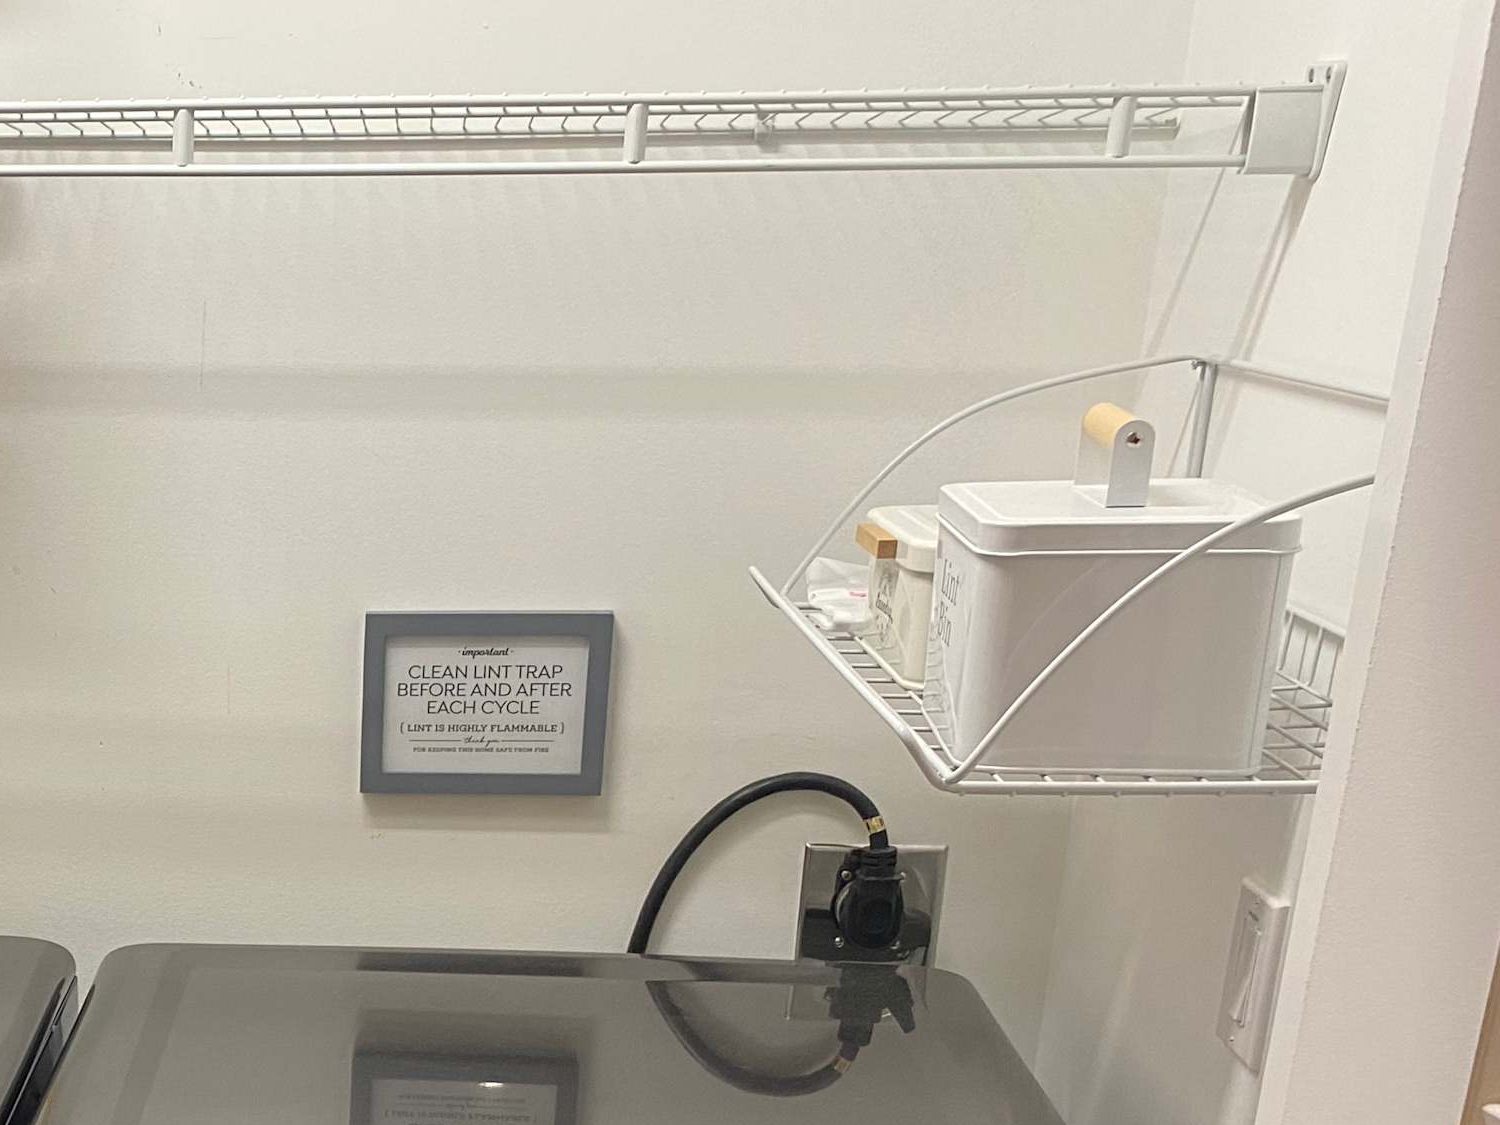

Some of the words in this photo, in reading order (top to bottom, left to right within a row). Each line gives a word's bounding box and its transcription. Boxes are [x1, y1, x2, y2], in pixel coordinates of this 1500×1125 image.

[941, 558, 959, 606] Lint
[938, 601, 951, 647] Bin
[461, 646, 509, 659] important
[408, 665, 468, 679] CLEAN
[473, 665, 512, 679] LINT
[515, 665, 563, 679] TRAP
[397, 682, 467, 697] BEFORE
[470, 682, 512, 697] AND
[515, 682, 572, 697] AFTER
[427, 700, 476, 715] EACH
[481, 700, 541, 715] CYCLE
[407, 724, 433, 733] LINT
[435, 724, 445, 733] IS
[448, 724, 488, 733] HIGHLY
[490, 724, 558, 733] FLAMMABLE
